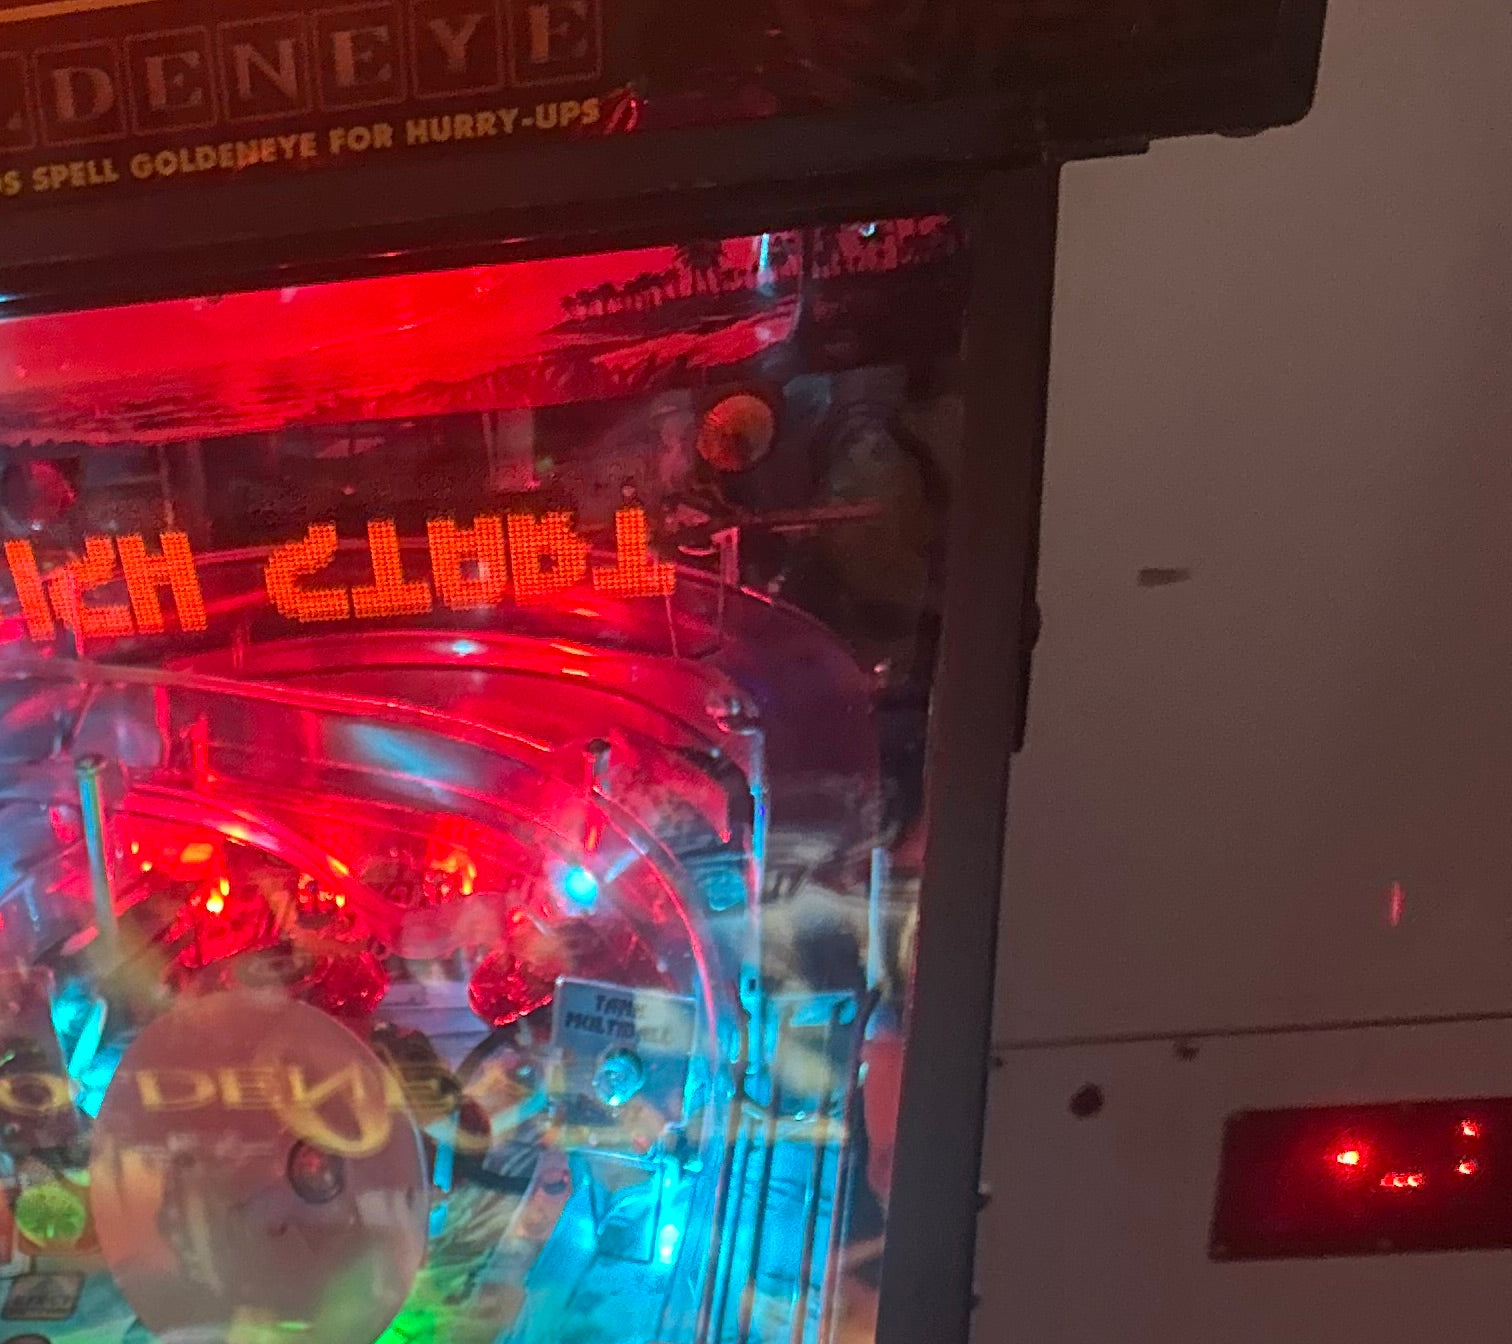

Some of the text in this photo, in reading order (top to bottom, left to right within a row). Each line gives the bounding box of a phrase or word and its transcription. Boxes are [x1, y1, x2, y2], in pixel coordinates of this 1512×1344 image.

[32, 158, 120, 192] SPELL
[130, 131, 318, 181] GOLDENEYE
[329, 122, 393, 155] FOR
[406, 97, 600, 146] HURRY-UPS
